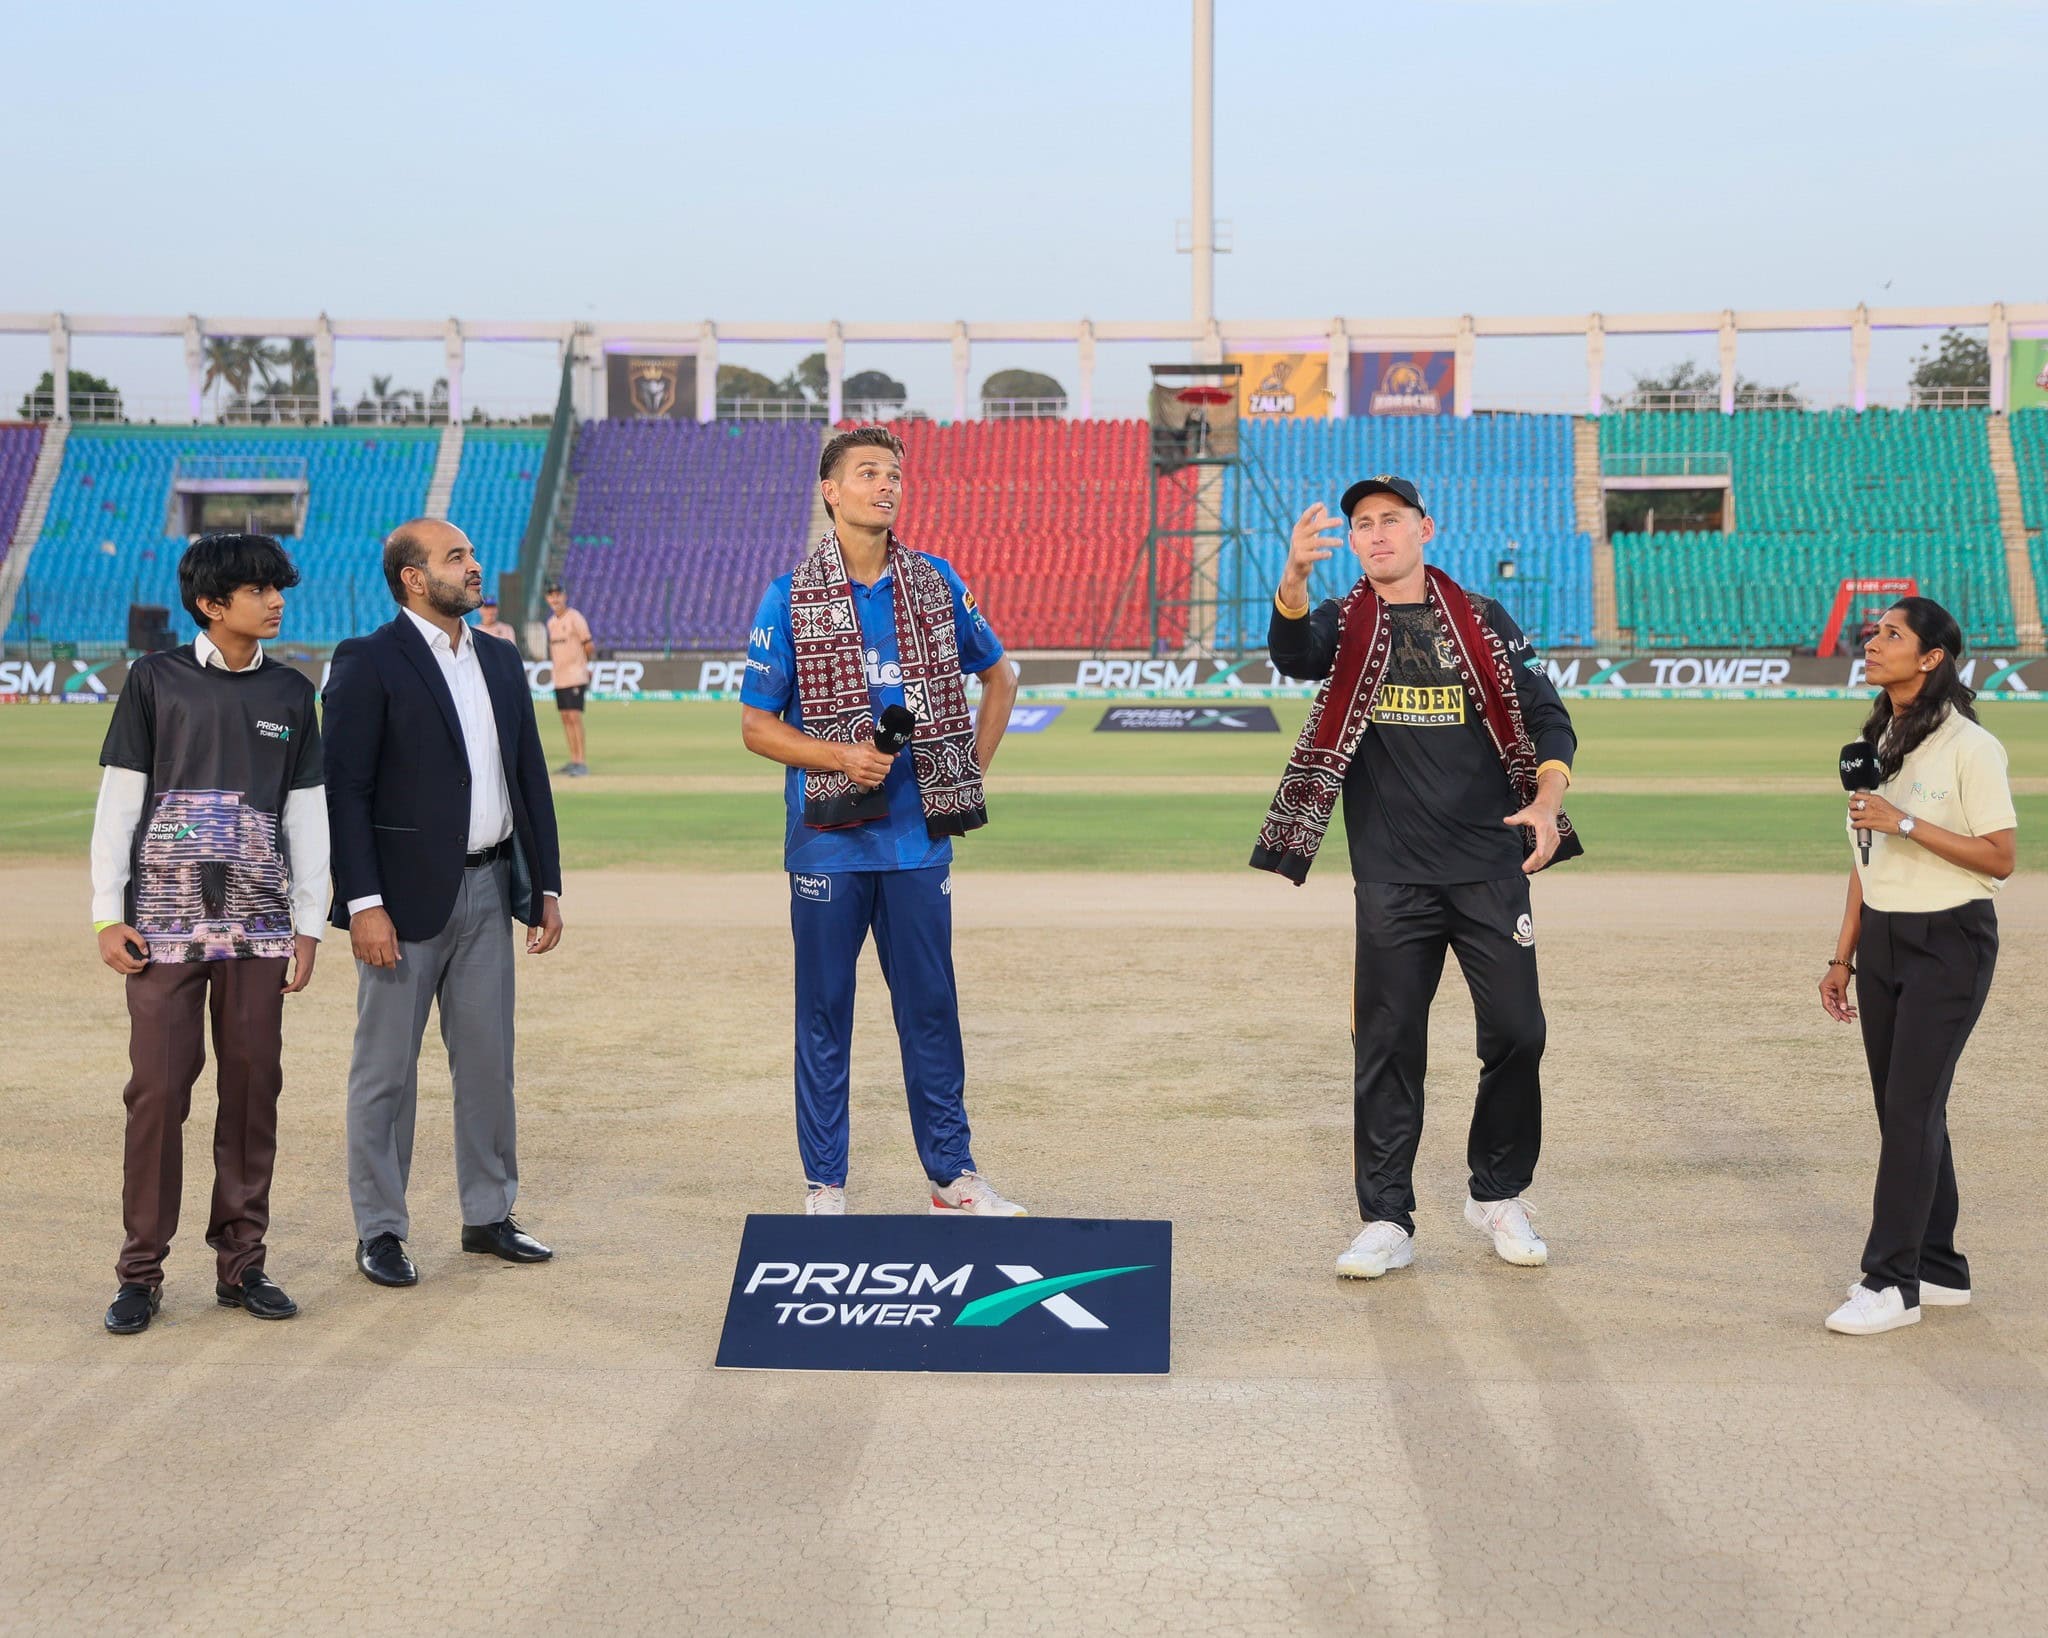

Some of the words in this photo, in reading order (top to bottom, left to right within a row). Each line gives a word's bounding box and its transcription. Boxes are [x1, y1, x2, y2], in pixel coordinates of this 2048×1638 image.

[1075, 660, 1198, 690] PRISM
[1650, 658, 1791, 688] TOWER
[1378, 686, 1461, 711] WISDEN
[256, 720, 284, 732] PRISM
[1110, 709, 1196, 721] PRISM
[1381, 712, 1455, 723] WISDEN.COM
[744, 1262, 975, 1296] PRISM
[774, 1302, 942, 1327] TOWER
